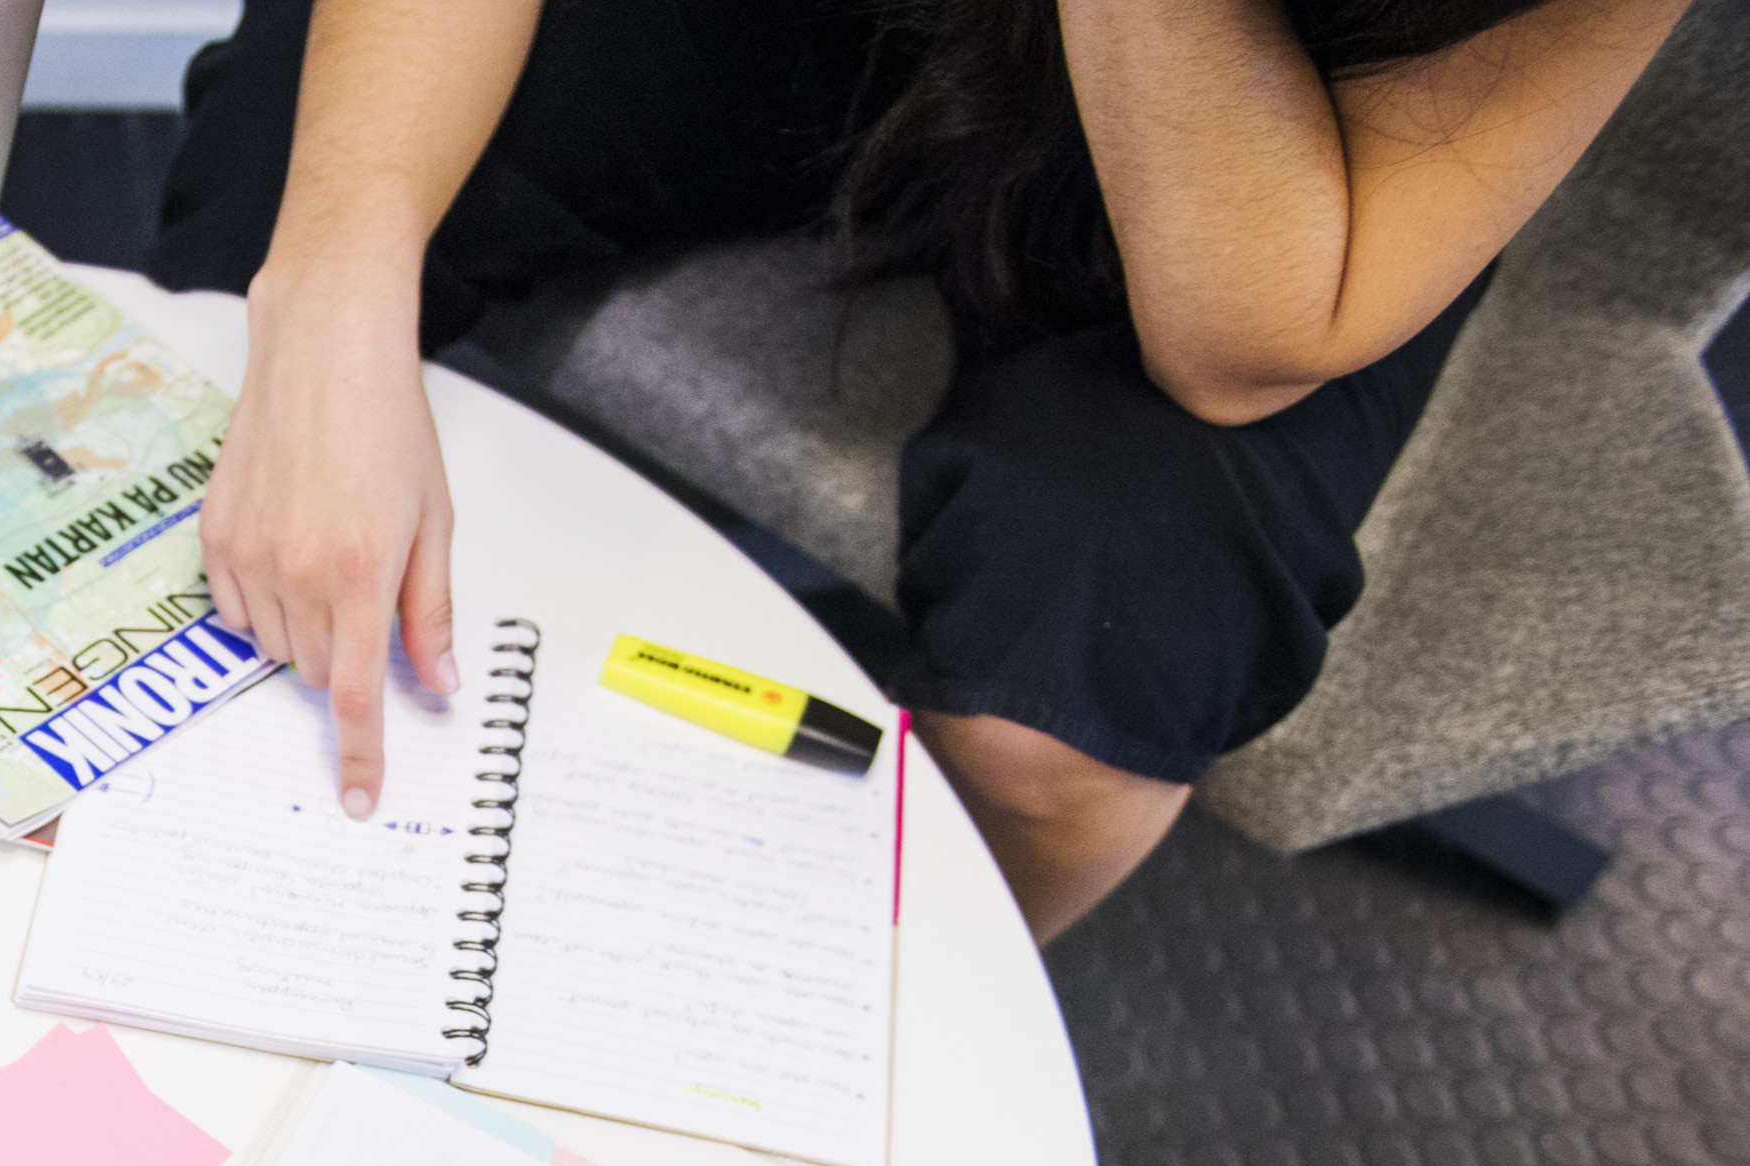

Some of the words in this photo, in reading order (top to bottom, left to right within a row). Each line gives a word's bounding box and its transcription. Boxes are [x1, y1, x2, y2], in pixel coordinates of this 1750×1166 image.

[119, 467, 178, 528] PÅ
[164, 444, 217, 494] NU
[1, 494, 131, 598] KARTAN
[26, 609, 261, 787] TRONIK
